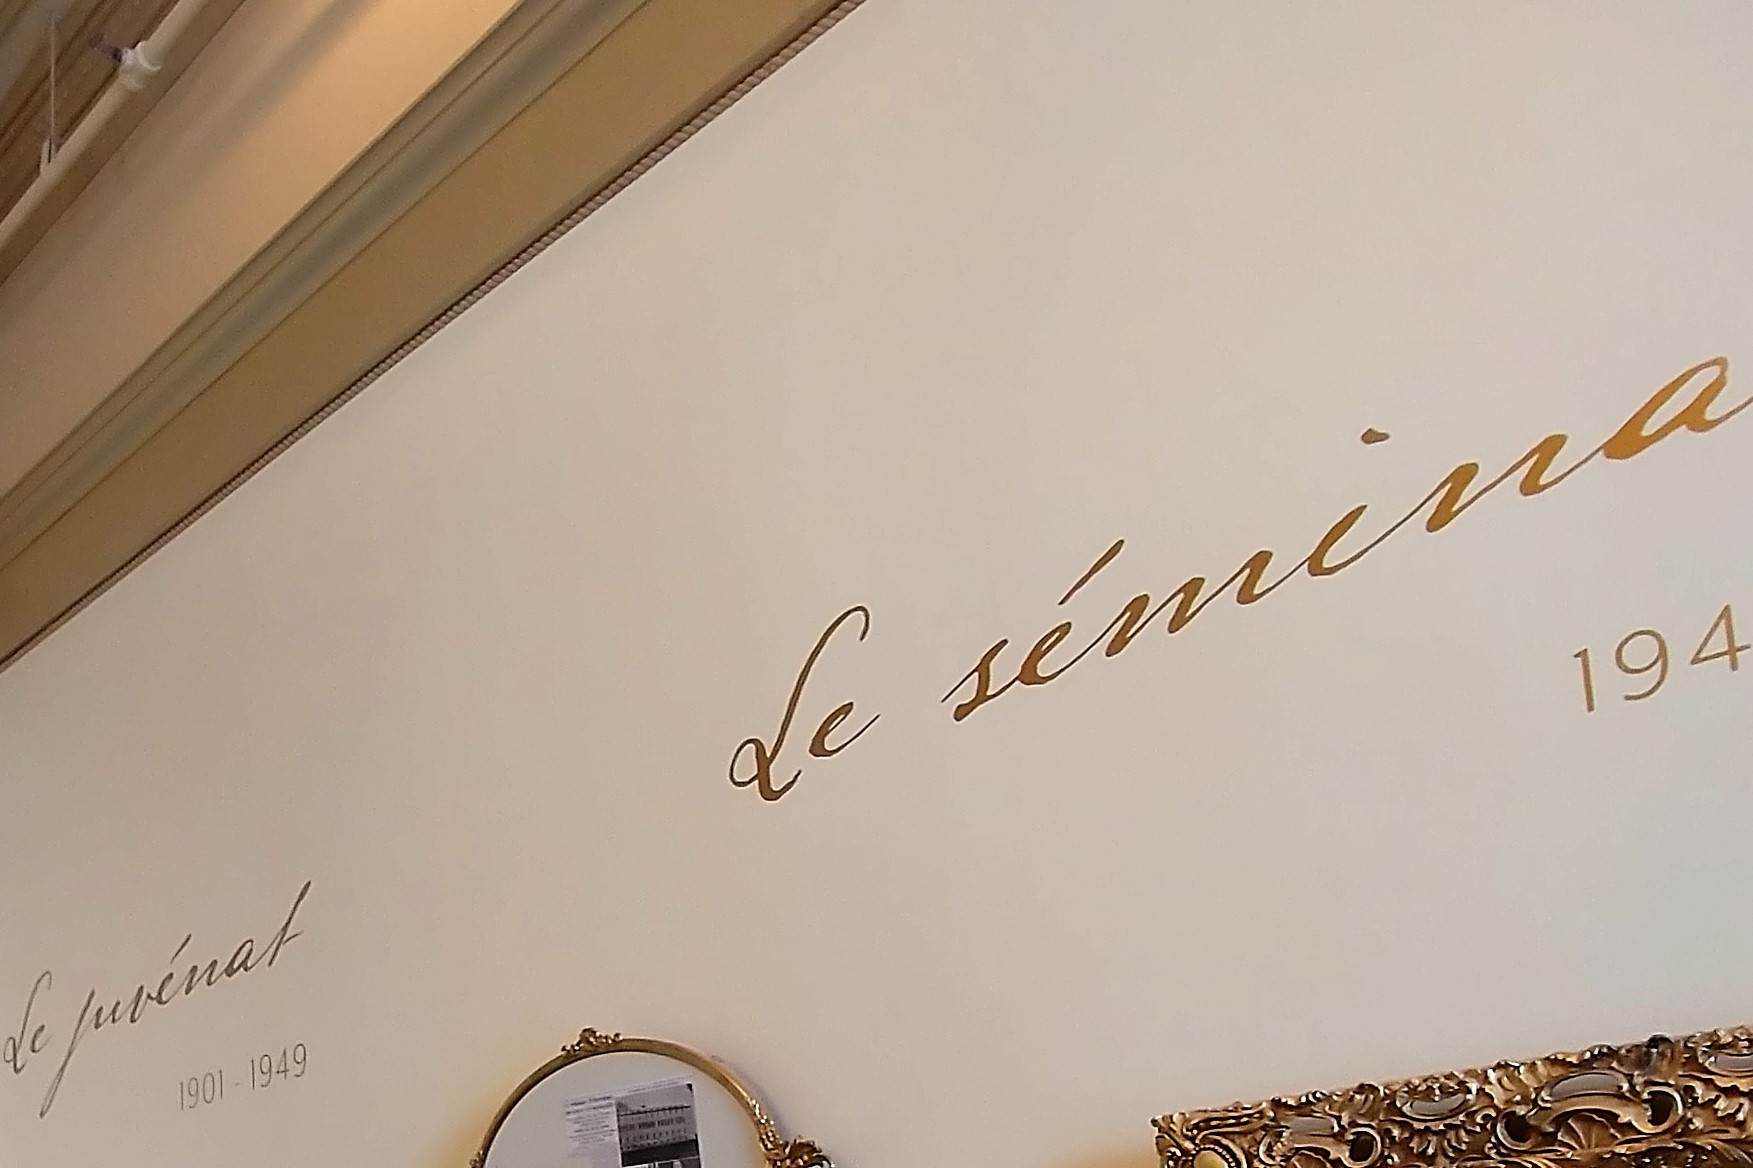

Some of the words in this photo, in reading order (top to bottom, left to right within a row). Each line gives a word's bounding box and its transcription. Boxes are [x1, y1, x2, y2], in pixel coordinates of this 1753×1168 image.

[729, 605, 880, 801] Le
[941, 356, 1753, 721] sémina
[1573, 604, 1752, 712] 194
[4, 970, 52, 1074] Le
[40, 880, 311, 1119] juvénat
[179, 1069, 224, 1111] 1901
[251, 1043, 308, 1090] 1949
